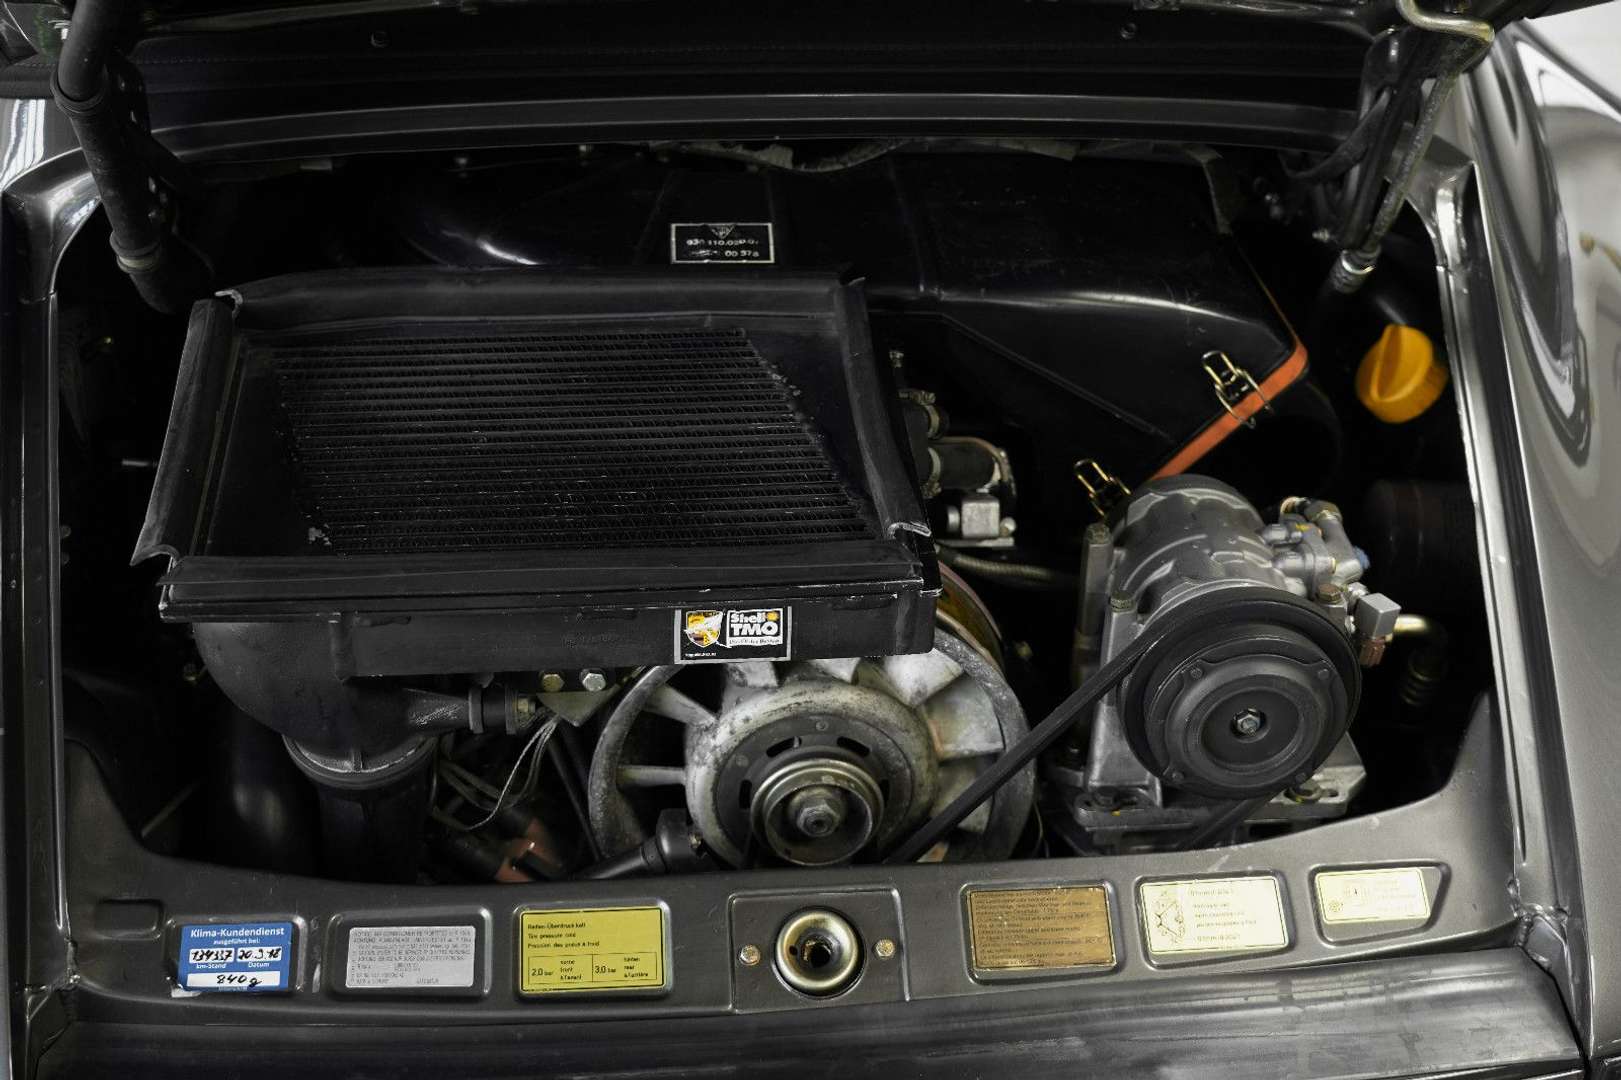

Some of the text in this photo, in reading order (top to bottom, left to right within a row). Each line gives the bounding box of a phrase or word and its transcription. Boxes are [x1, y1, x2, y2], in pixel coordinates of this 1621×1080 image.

[730, 612, 766, 623] Shell
[730, 621, 779, 636] TMO
[190, 927, 285, 938] Klima-Kundendienst
